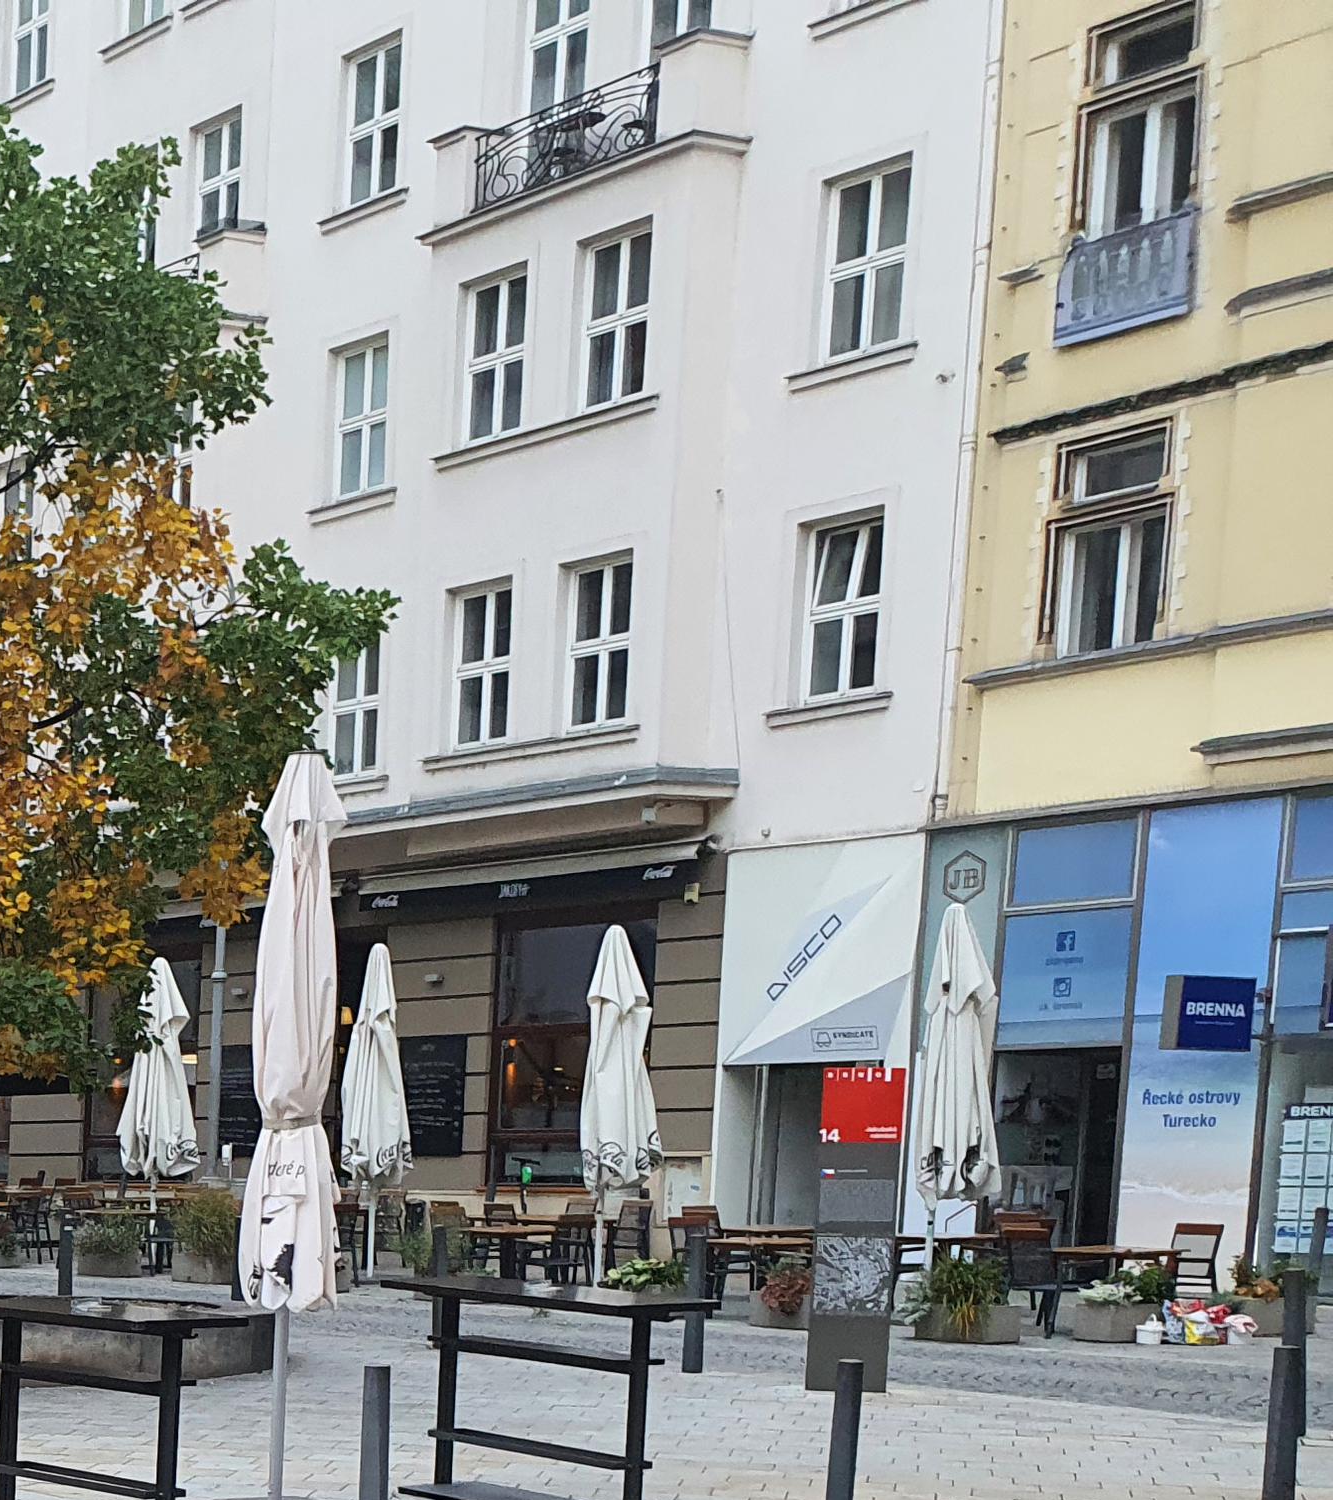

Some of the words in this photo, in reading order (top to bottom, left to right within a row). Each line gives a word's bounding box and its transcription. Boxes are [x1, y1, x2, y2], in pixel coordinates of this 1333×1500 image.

[766, 913, 842, 1001] DISCO
[1186, 1002, 1246, 1018] BRENNA
[1142, 1088, 1184, 1105] Řecké
[1188, 1090, 1241, 1106] ostrovy
[1162, 1114, 1217, 1128] Turecko
[819, 1128, 841, 1143] 14
